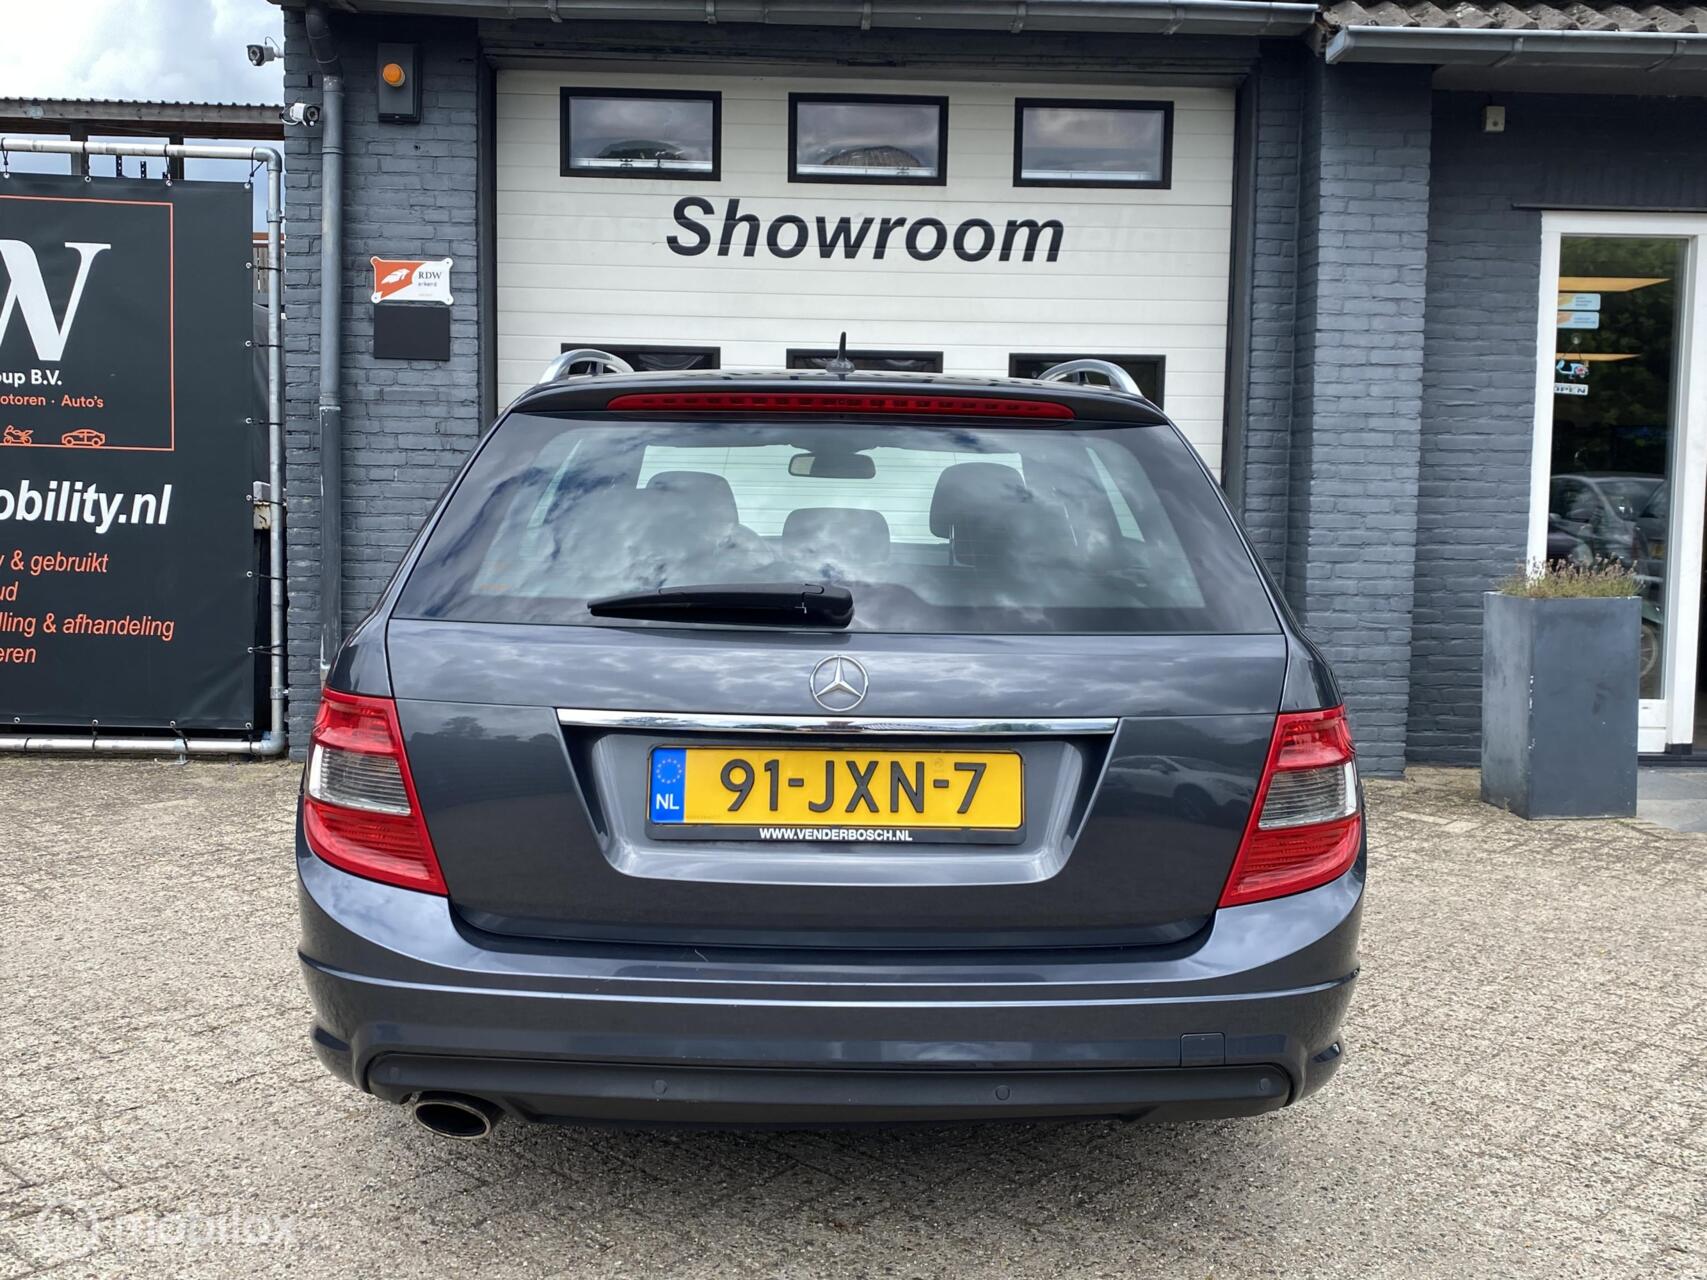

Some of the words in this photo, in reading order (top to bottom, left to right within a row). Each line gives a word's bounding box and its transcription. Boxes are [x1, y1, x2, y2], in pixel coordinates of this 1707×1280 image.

[665, 196, 1065, 263] Showroom
[418, 271, 442, 280] RDW
[0, 371, 26, 388] up
[31, 369, 62, 386] B.V.
[0, 394, 46, 406] otoren
[61, 394, 104, 408] Auto's
[0, 480, 172, 534] obility.nl
[10, 549, 24, 571] &
[31, 551, 109, 576] gebruikt
[43, 612, 57, 634] &
[63, 614, 175, 641] afhandeling
[719, 758, 987, 814] 91-JXN-7
[656, 794, 680, 810] NL
[759, 827, 913, 841] WWW.VENDERBOSCH.NL
